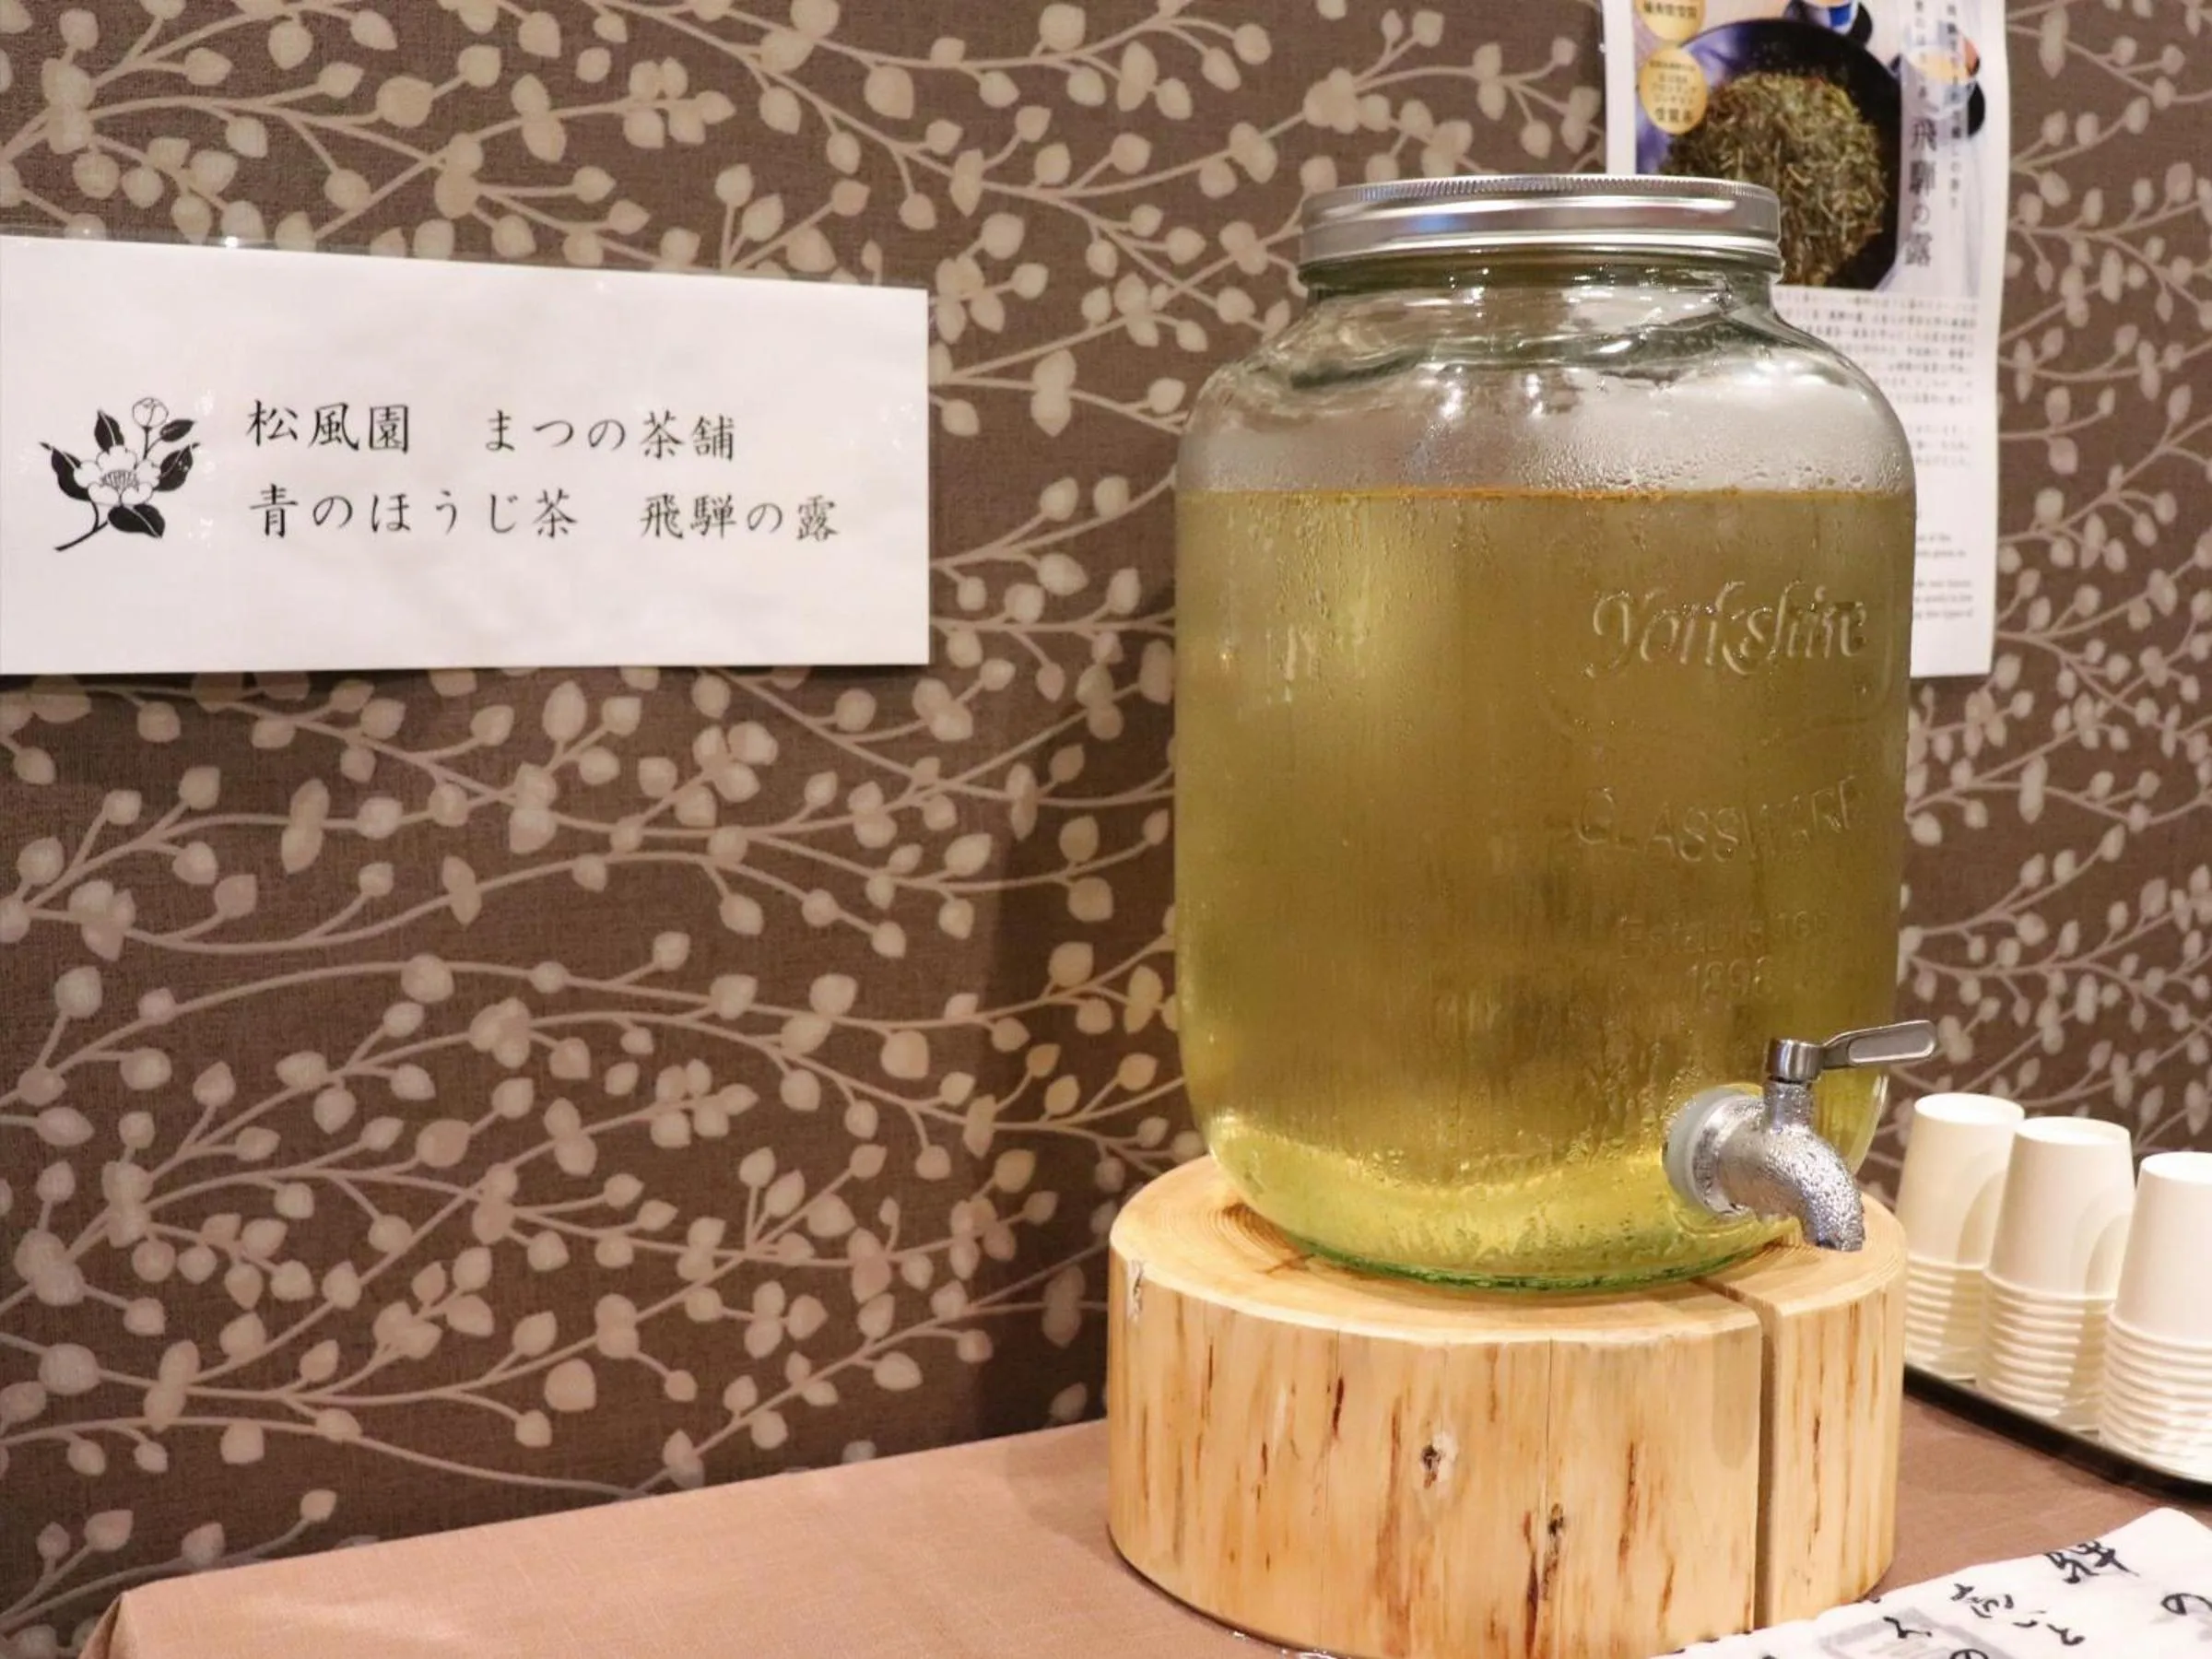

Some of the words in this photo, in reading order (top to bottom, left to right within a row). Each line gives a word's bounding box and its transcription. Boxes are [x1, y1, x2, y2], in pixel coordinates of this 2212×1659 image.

[247, 398, 410, 455] 松風園
[487, 408, 735, 463] まつの茶舗
[250, 482, 578, 539] 青のほうじ茶
[641, 492, 840, 542] 飛騨の露
